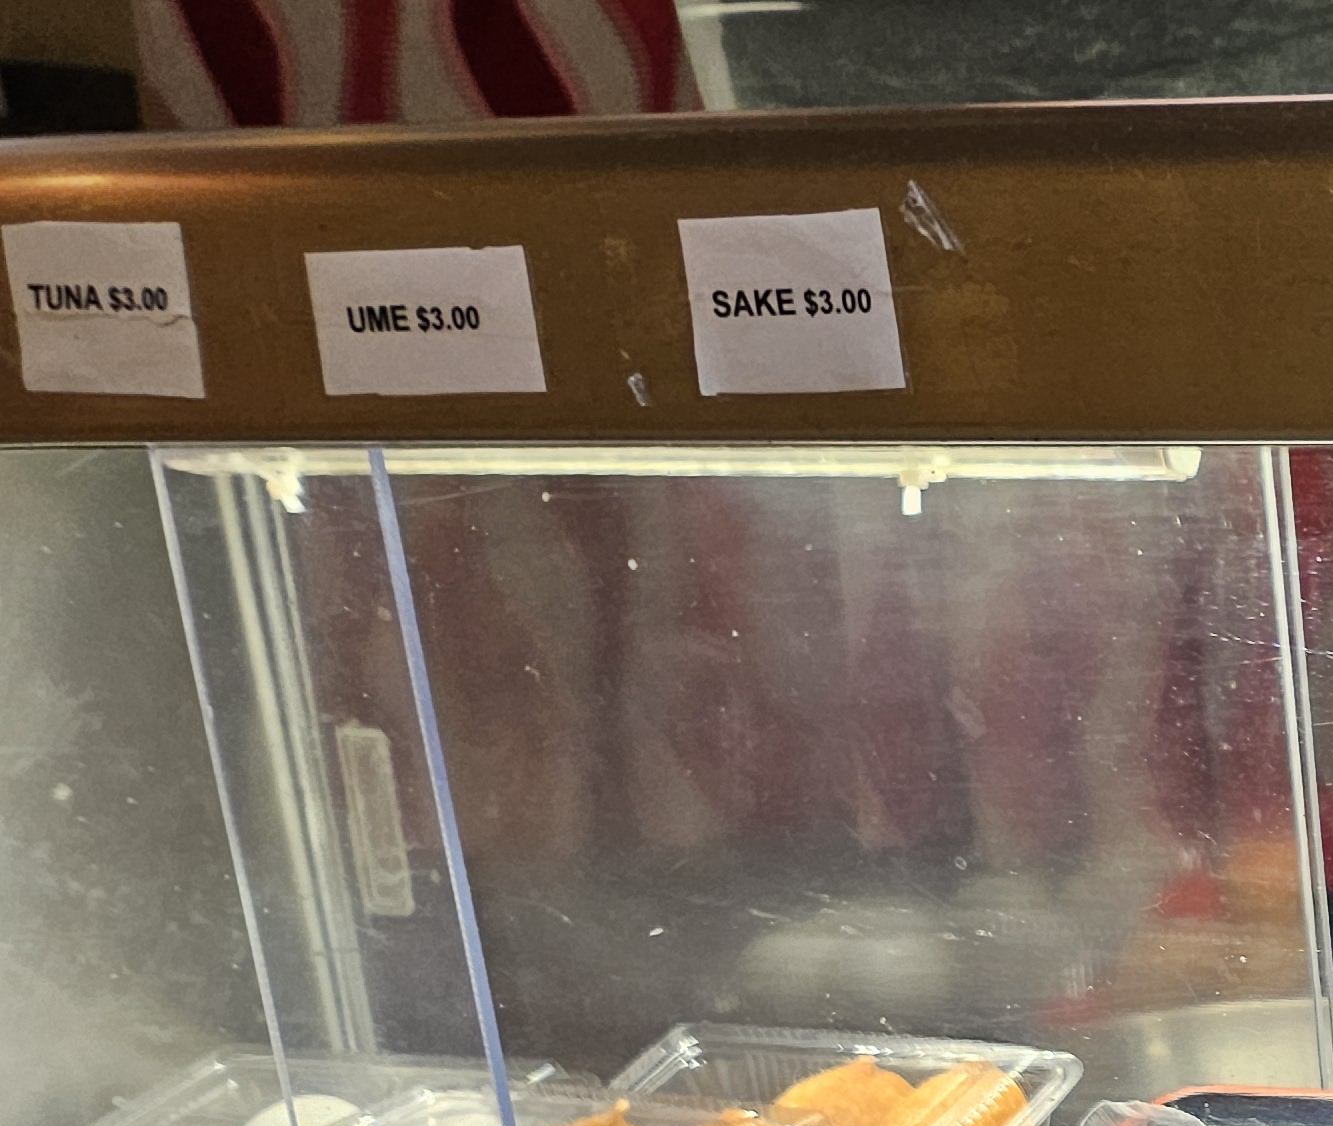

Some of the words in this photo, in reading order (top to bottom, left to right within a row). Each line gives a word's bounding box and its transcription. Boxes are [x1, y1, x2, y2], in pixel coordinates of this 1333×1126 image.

[27, 283, 103, 312] TUNA
[107, 286, 169, 313] $3.00
[711, 288, 797, 319] SAKE
[803, 288, 872, 319] $3.00
[346, 304, 411, 334] UME
[415, 305, 481, 334] $3.00
